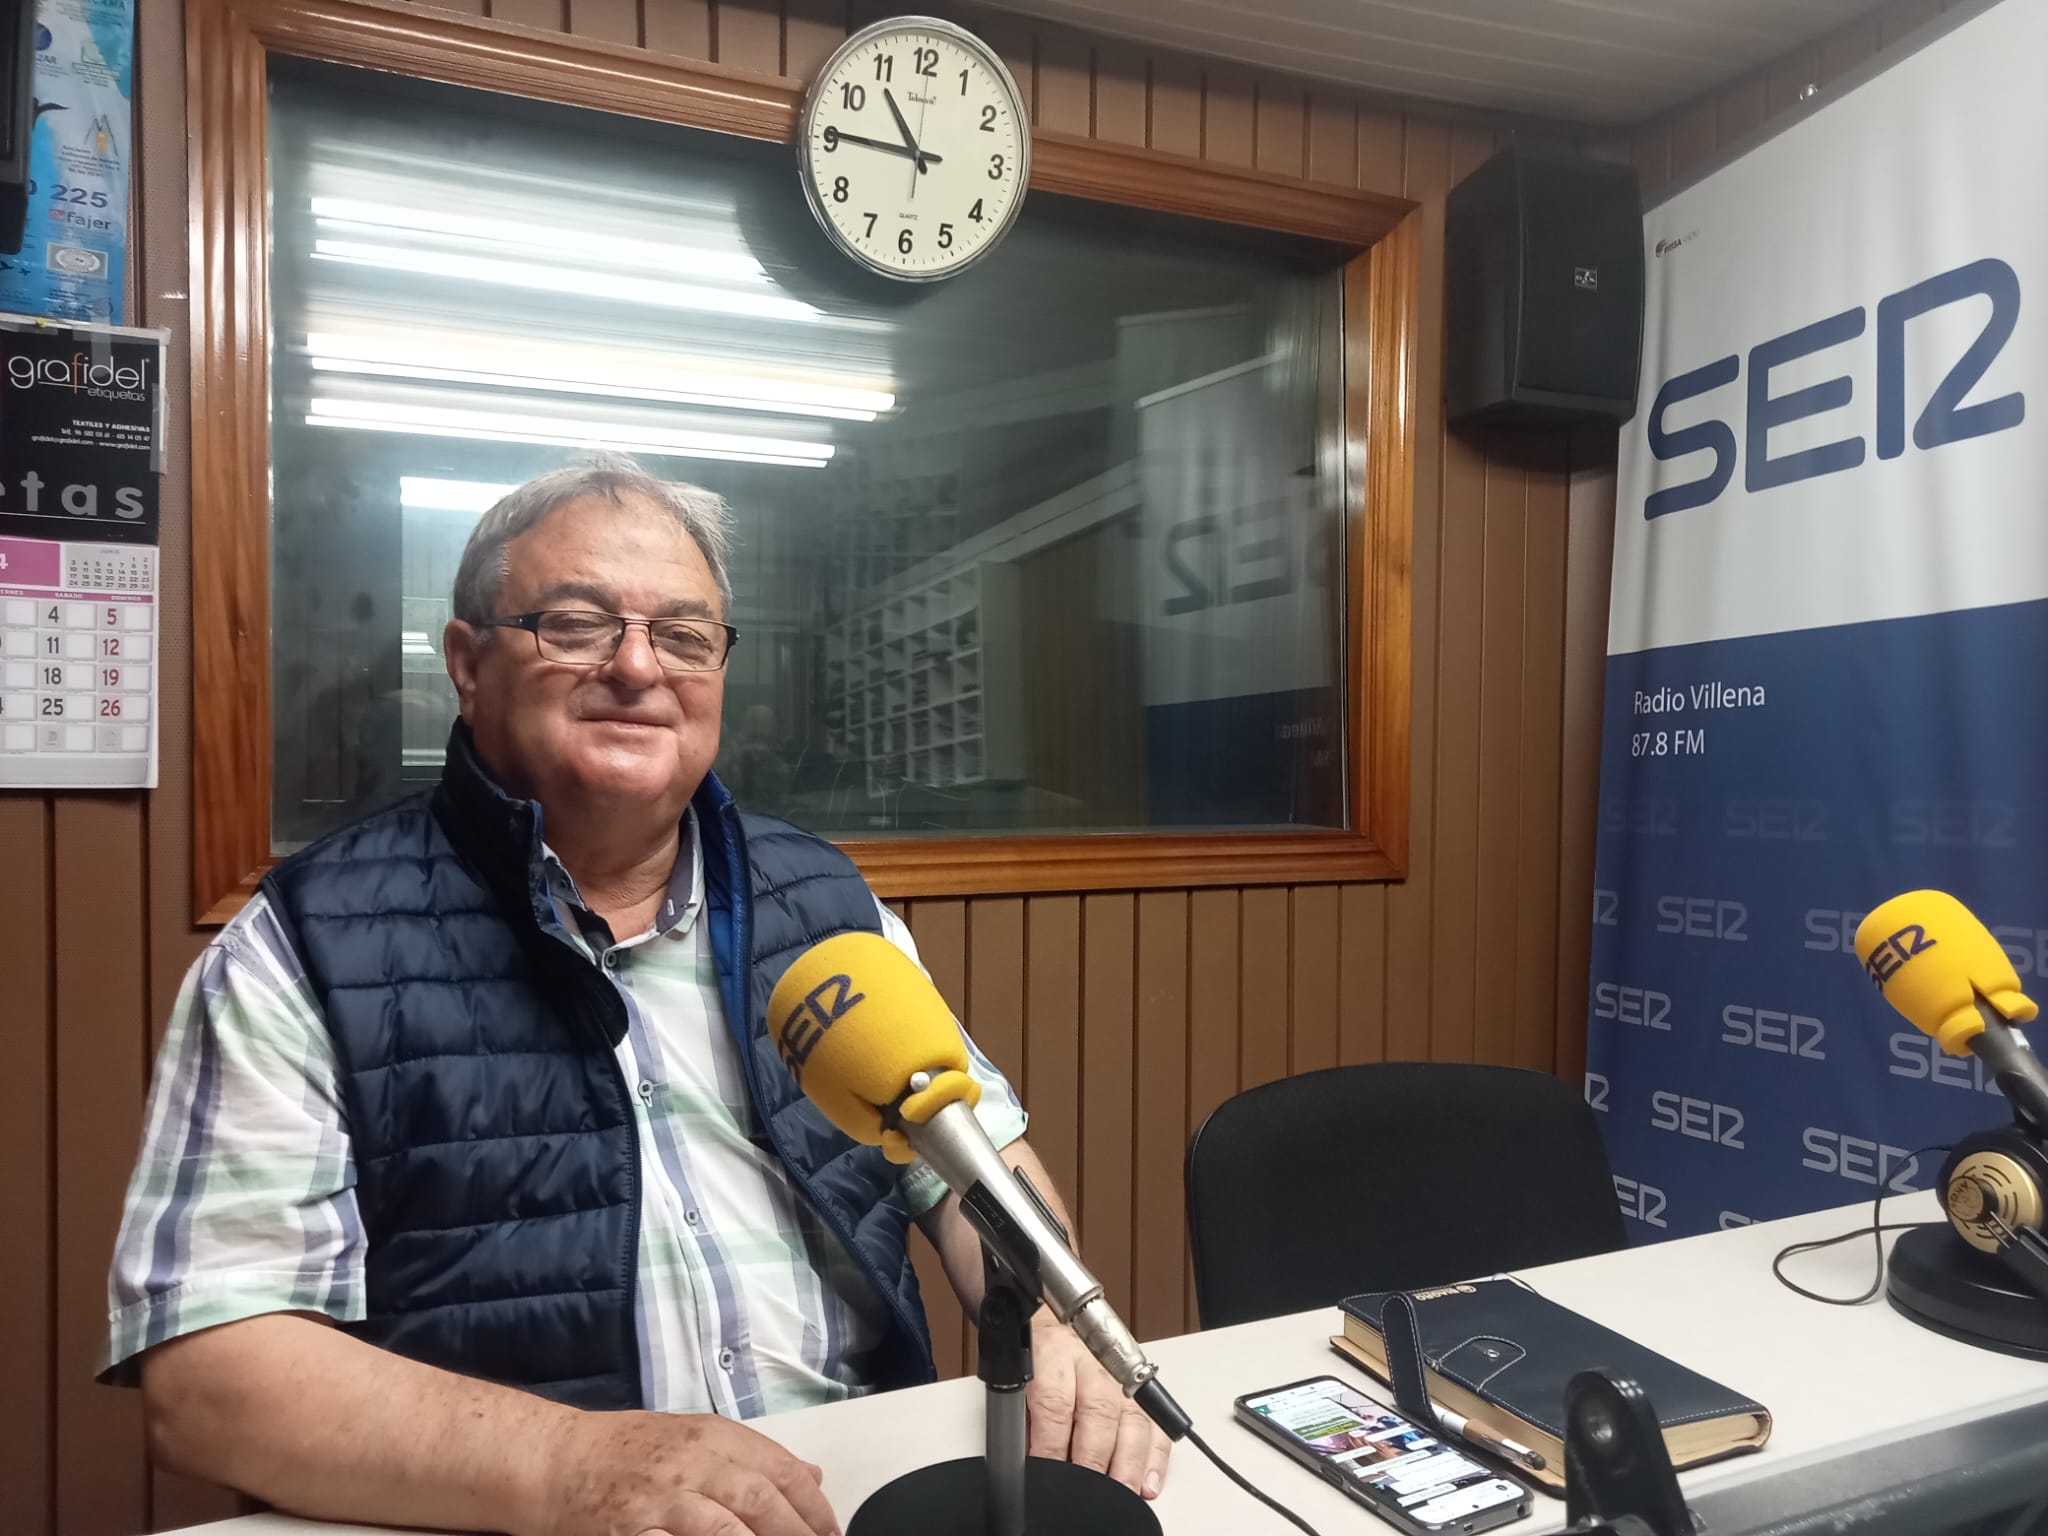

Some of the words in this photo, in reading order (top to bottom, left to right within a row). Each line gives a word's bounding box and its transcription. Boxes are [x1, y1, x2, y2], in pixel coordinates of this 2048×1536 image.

[873, 53, 893, 83] 11
[913, 47, 940, 78] 12
[959, 69, 969, 96] 1
[840, 82, 866, 112] 10
[979, 105, 997, 132] 2
[823, 126, 839, 153] 9
[987, 154, 1004, 180] 3
[50, 184, 108, 208] 225
[833, 176, 849, 203] 8
[67, 212, 111, 230] fajer
[968, 198, 984, 223] 4
[863, 212, 878, 238] 7
[937, 223, 954, 249] 5
[898, 229, 913, 254] 6
[8, 353, 145, 393] grafidel
[88, 387, 145, 402] etiquetas
[1644, 258, 2025, 521] SER
[0, 471, 144, 519] tas
[48, 605, 59, 623] 4
[107, 608, 117, 625] 5
[47, 636, 60, 654] 11
[103, 638, 119, 655] 12
[44, 667, 61, 685] 18
[103, 668, 119, 686] 19
[42, 698, 64, 716] 25
[100, 699, 121, 717] 26
[1634, 687, 1685, 715] Radio
[1690, 681, 1766, 710] Villena
[1632, 731, 1668, 757] 87.8
[1674, 729, 1705, 755] FM
[1657, 896, 1748, 941] SER
[1804, 909, 1864, 954] SE
[1595, 982, 1671, 1031] SER
[1722, 1005, 1825, 1060] SER
[1652, 1091, 1744, 1150] SER
[1803, 1127, 1919, 1194] SER
[1612, 1174, 1667, 1228] ER
